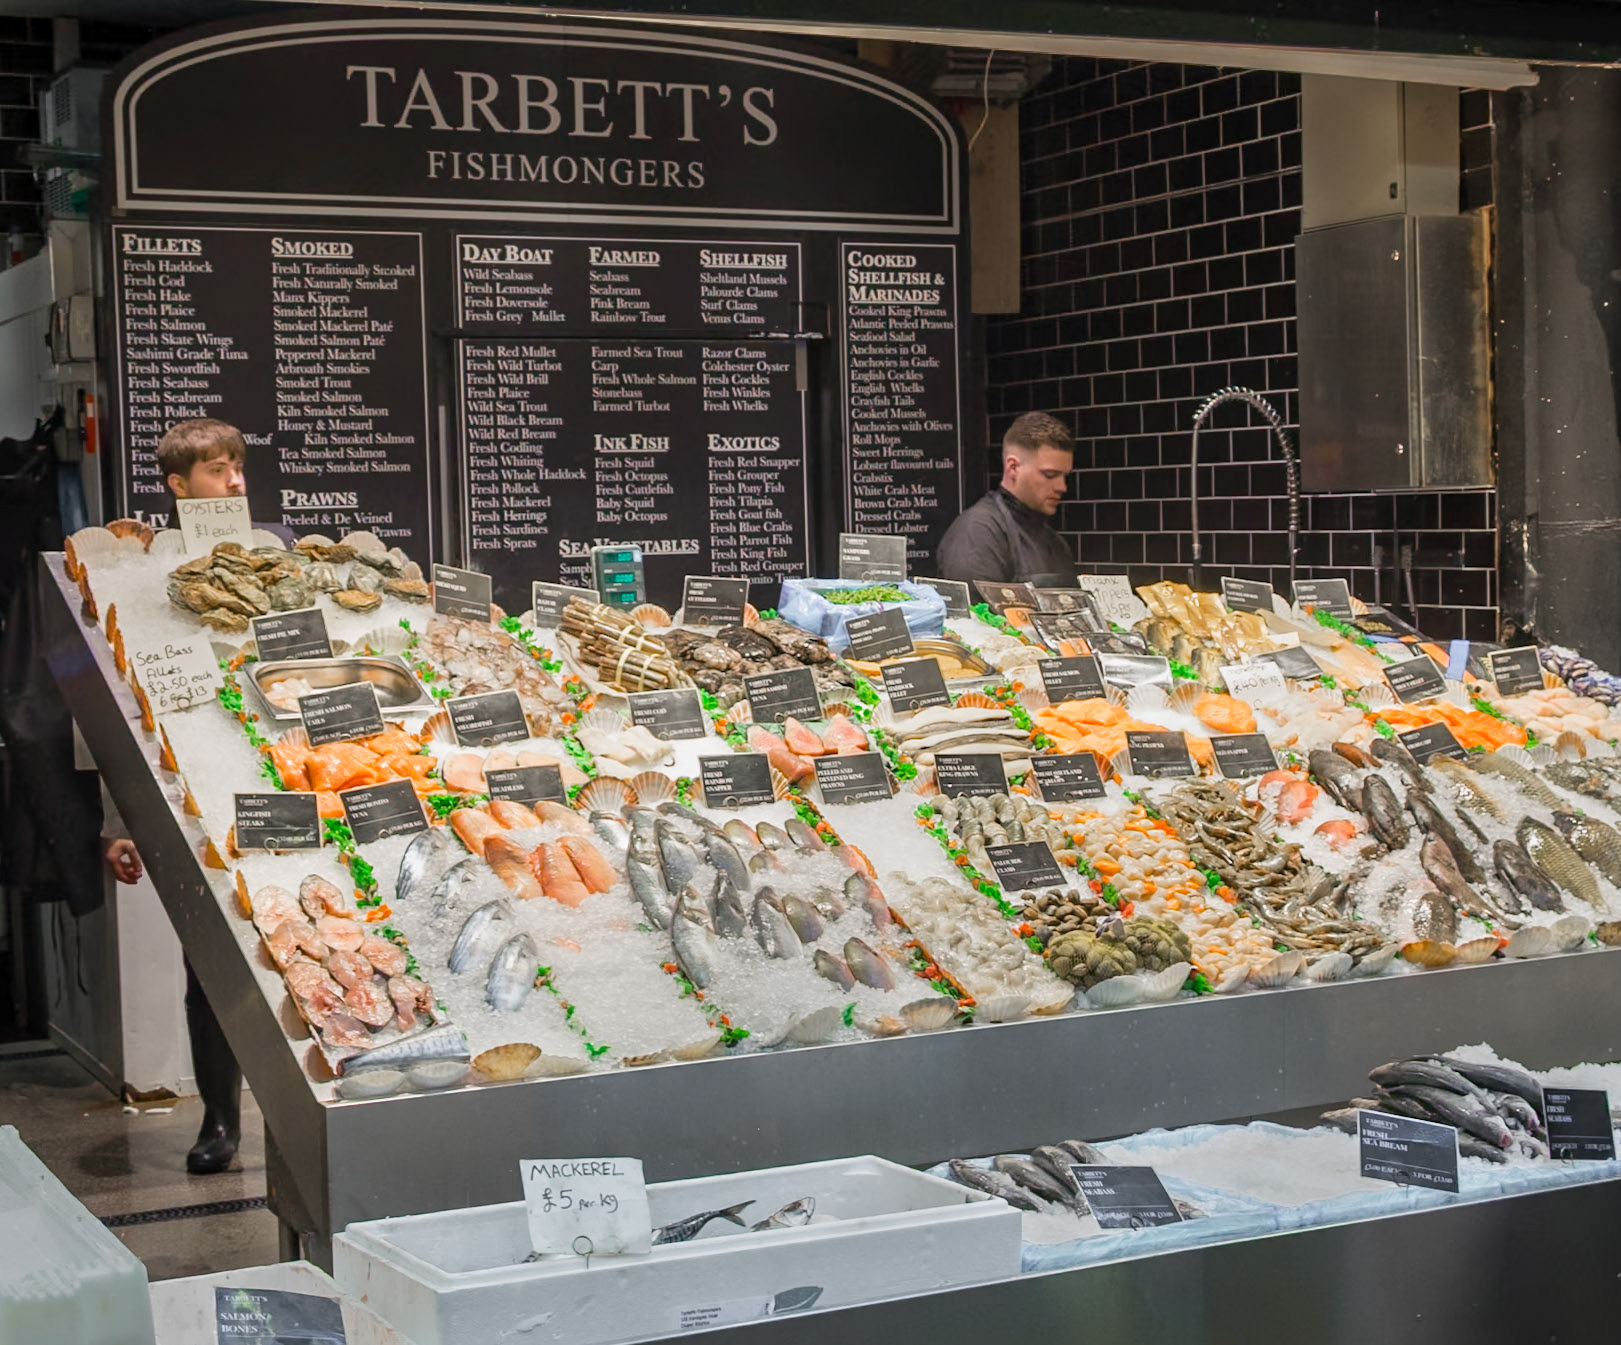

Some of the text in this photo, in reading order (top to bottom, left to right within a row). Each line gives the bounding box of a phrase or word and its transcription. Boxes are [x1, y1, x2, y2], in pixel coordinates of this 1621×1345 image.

[346, 65, 778, 146] TARBETT’S
[427, 150, 705, 188] FISHMONGERS
[122, 234, 202, 254] FILLETS
[272, 238, 353, 256] SMOKED
[463, 244, 553, 262] DAY BOAT
[589, 247, 660, 263] FARMED
[701, 250, 787, 267] SHELLFISH
[848, 251, 916, 267] COOKED
[123, 260, 213, 273] Fresh Haddock
[124, 275, 184, 286] Fresh Cod
[464, 269, 533, 280] Wild Seabass
[590, 271, 629, 281] Seabass
[848, 268, 945, 285] SHELLFISH &
[273, 277, 397, 292] Fresh Naturally Smoked
[125, 290, 191, 301] Fresh Hake
[701, 287, 778, 298] Palourde Clams
[849, 286, 939, 302] MARINADES
[273, 292, 350, 307] Manx Kippers
[465, 297, 548, 308] Fresh Doversole
[591, 298, 649, 308] Pink Bream
[125, 305, 195, 316] Fresh Plaice
[591, 311, 666, 322] Rainbow Trout
[126, 319, 205, 331] Fresh Salmon
[274, 321, 316, 331] Smoked
[320, 321, 367, 332] Mackerel
[127, 334, 233, 348] Fresh Skate Wings
[127, 348, 248, 360] Sashimi Grade Tuna
[275, 349, 375, 363] Peppered Mackerel
[466, 346, 556, 357] Fresh Red Mullet
[128, 363, 220, 374] Fresh Swordfish
[276, 364, 370, 374] Arbroath Smokies
[592, 361, 618, 374] Carp
[702, 361, 789, 373] Colchester Oyster
[128, 378, 209, 388] Fresh Seabass
[276, 378, 351, 388] Smoked Trout
[703, 374, 770, 384] Fresh Cockles
[129, 392, 222, 403] Fresh Seabream
[593, 388, 642, 398] Stonebass
[130, 407, 207, 417] Fresh Pollock
[277, 406, 388, 417] Kiln Smoked Salmon
[593, 401, 670, 411] Farmed Turbot
[278, 420, 373, 434] Honey & Mustard
[594, 434, 669, 450] INK FISH
[708, 434, 779, 450] EXOTICS
[470, 443, 543, 455] Fresh Codling
[280, 462, 410, 476] Whiskey Smoked Salmon
[596, 471, 668, 483] Fresh Octopus
[854, 473, 893, 483] Crabstix
[281, 489, 358, 506] PRAWNS
[710, 496, 773, 508] Fresh Tilapia
[182, 500, 243, 514] OYSTERS
[597, 498, 654, 510] Baby Squid
[282, 513, 392, 525] Peeled & De Veined
[472, 511, 547, 523] Fresh Herrings
[212, 524, 238, 537] each
[711, 522, 792, 532] Fresh Blue Crabs
[855, 523, 928, 534] Dressed Lobster
[473, 539, 536, 551] Fresh Sprats
[136, 645, 193, 666] Sea Bass
[1380, 1141, 1407, 1151] BREAM
[531, 1162, 624, 1181] MACKEREL
